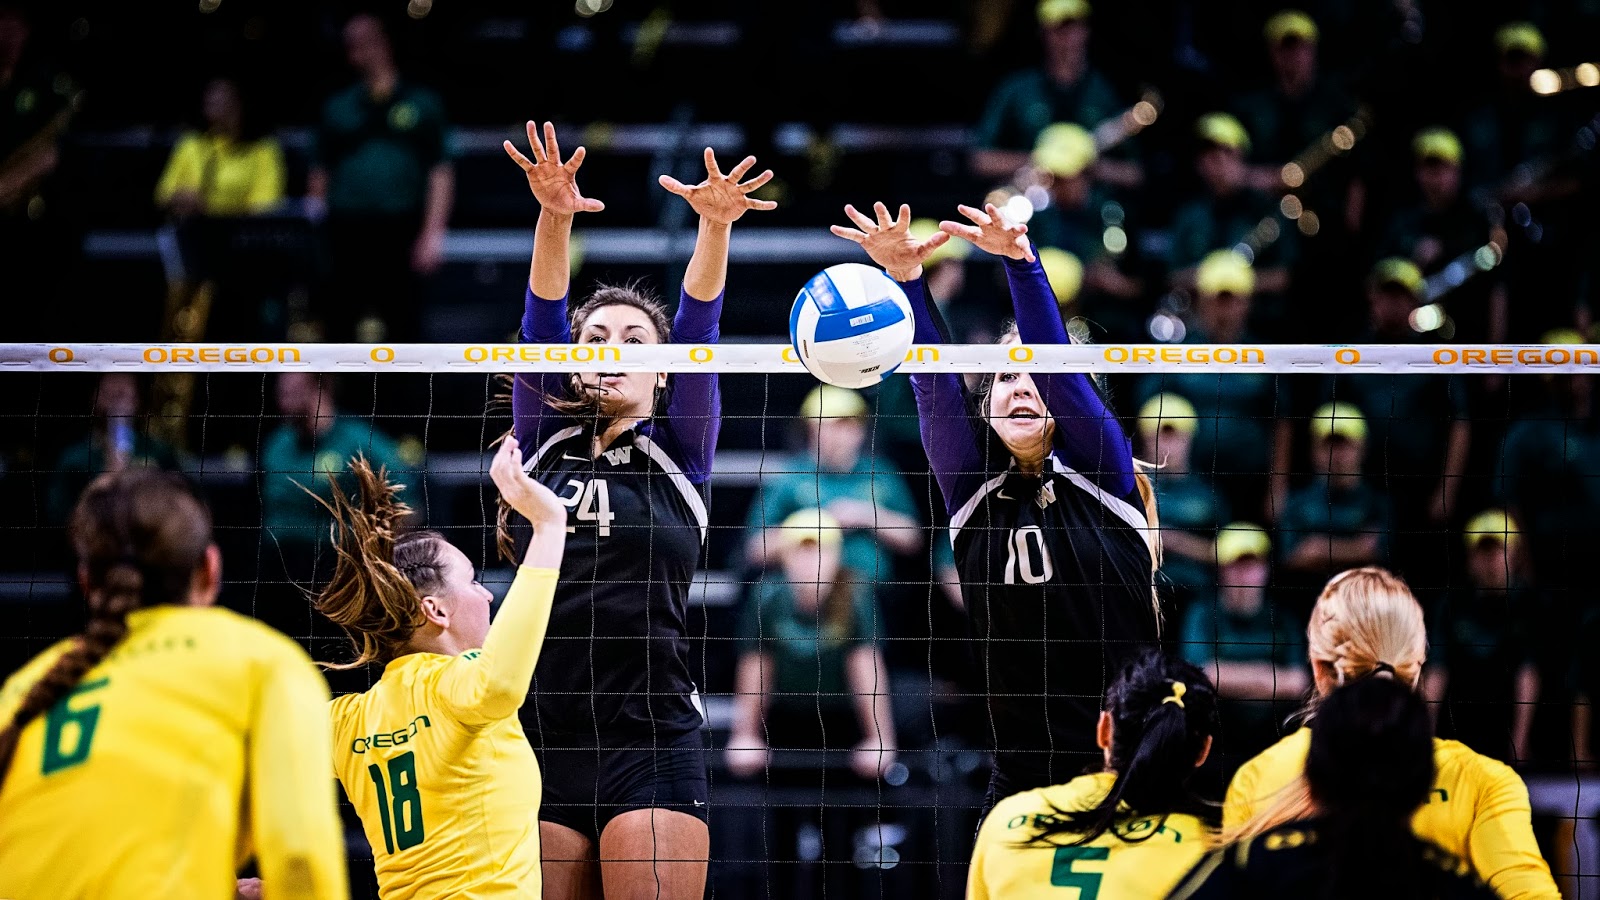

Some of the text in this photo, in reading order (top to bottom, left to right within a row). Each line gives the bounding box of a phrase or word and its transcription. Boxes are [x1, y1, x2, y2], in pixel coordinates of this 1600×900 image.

[48, 346, 1599, 365] O OREGON O OREGON O O OREGON O OREGON
[602, 445, 633, 466] W
[1004, 524, 1054, 584] 10
[41, 676, 112, 776] 6
[368, 750, 425, 854] 18
[1050, 845, 1111, 900] 5
